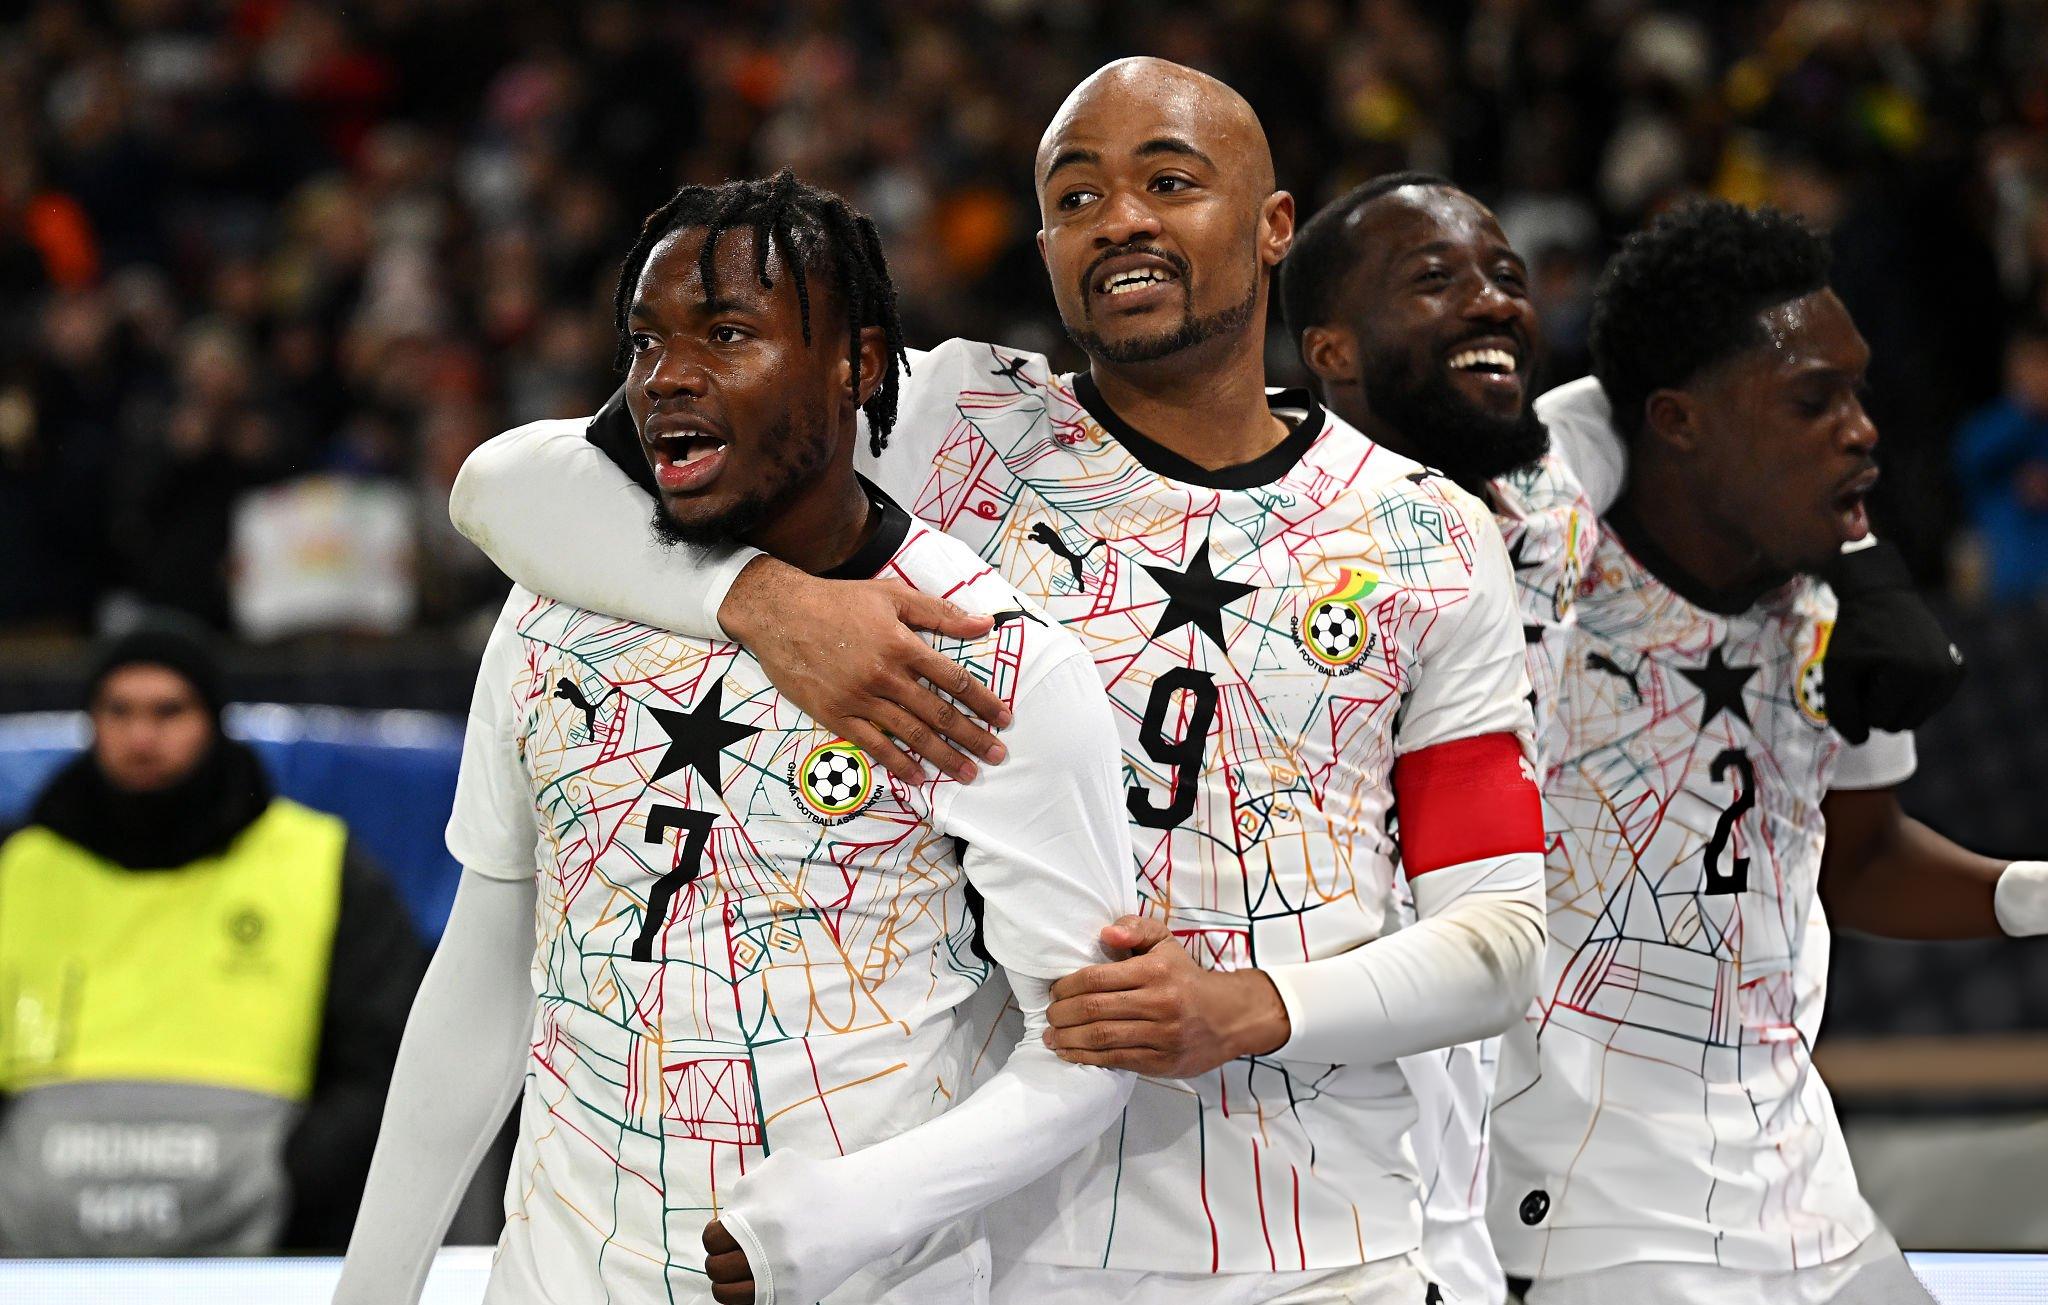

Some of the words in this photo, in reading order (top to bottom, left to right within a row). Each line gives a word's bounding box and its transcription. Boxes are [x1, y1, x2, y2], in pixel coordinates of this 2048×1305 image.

[1299, 649, 1337, 677] FOOTBALL
[1339, 633, 1377, 677] ASSOCIATION
[787, 762, 797, 797] GHANA
[793, 797, 836, 827] FOOTBALL
[1126, 666, 1219, 830] 9
[1704, 748, 1755, 895] 2
[631, 804, 720, 962] 7
